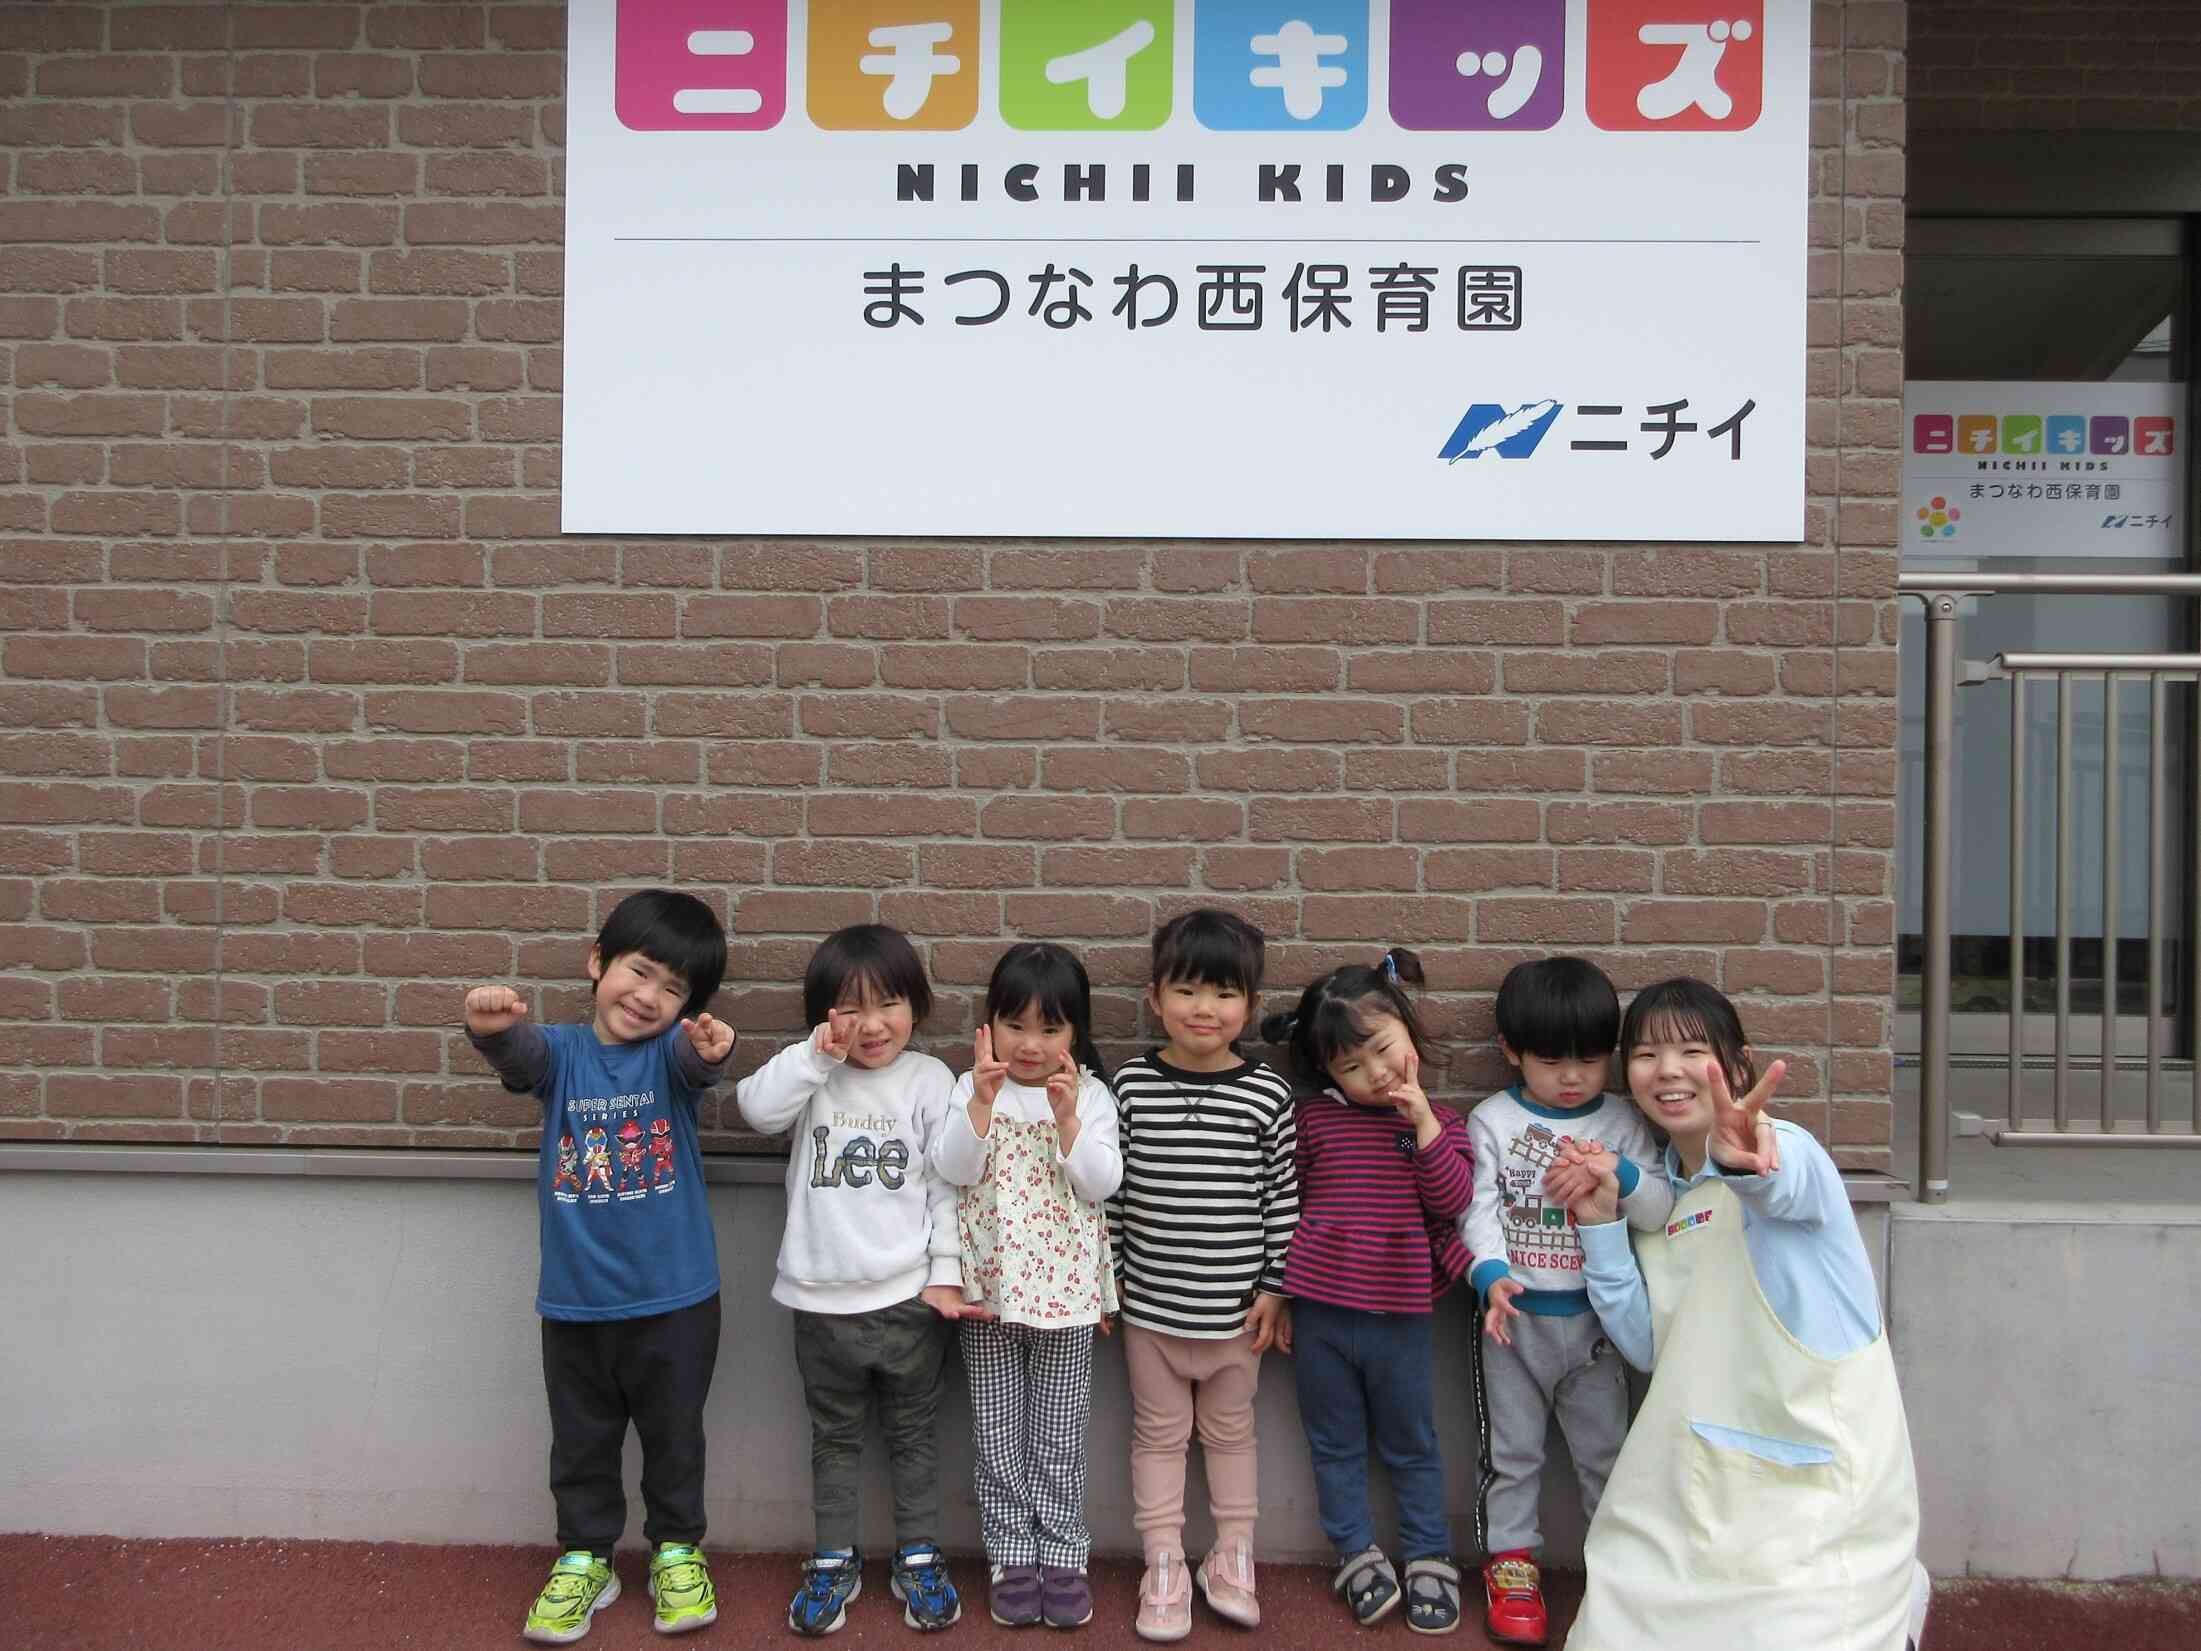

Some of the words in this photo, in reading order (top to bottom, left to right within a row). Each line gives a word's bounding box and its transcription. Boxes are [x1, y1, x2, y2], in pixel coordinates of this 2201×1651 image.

[673, 20, 1752, 119] ニチイキッズ
[897, 164, 1194, 202] NICHII
[1259, 164, 1469, 202] KIDS
[863, 262, 1523, 332] まつなわ西保育園
[1571, 399, 1756, 460] ニチイ
[1926, 428, 2172, 453] ニチイキッズ
[1977, 460, 2047, 471] NICHII
[2060, 461, 2108, 471] KIDS
[2129, 514, 2173, 529] ニチイ
[609, 1090, 656, 1110] SENTAI
[832, 1111, 897, 1134] Buddy
[811, 1126, 909, 1190] Lee
[1510, 1249, 1546, 1269] NICE
